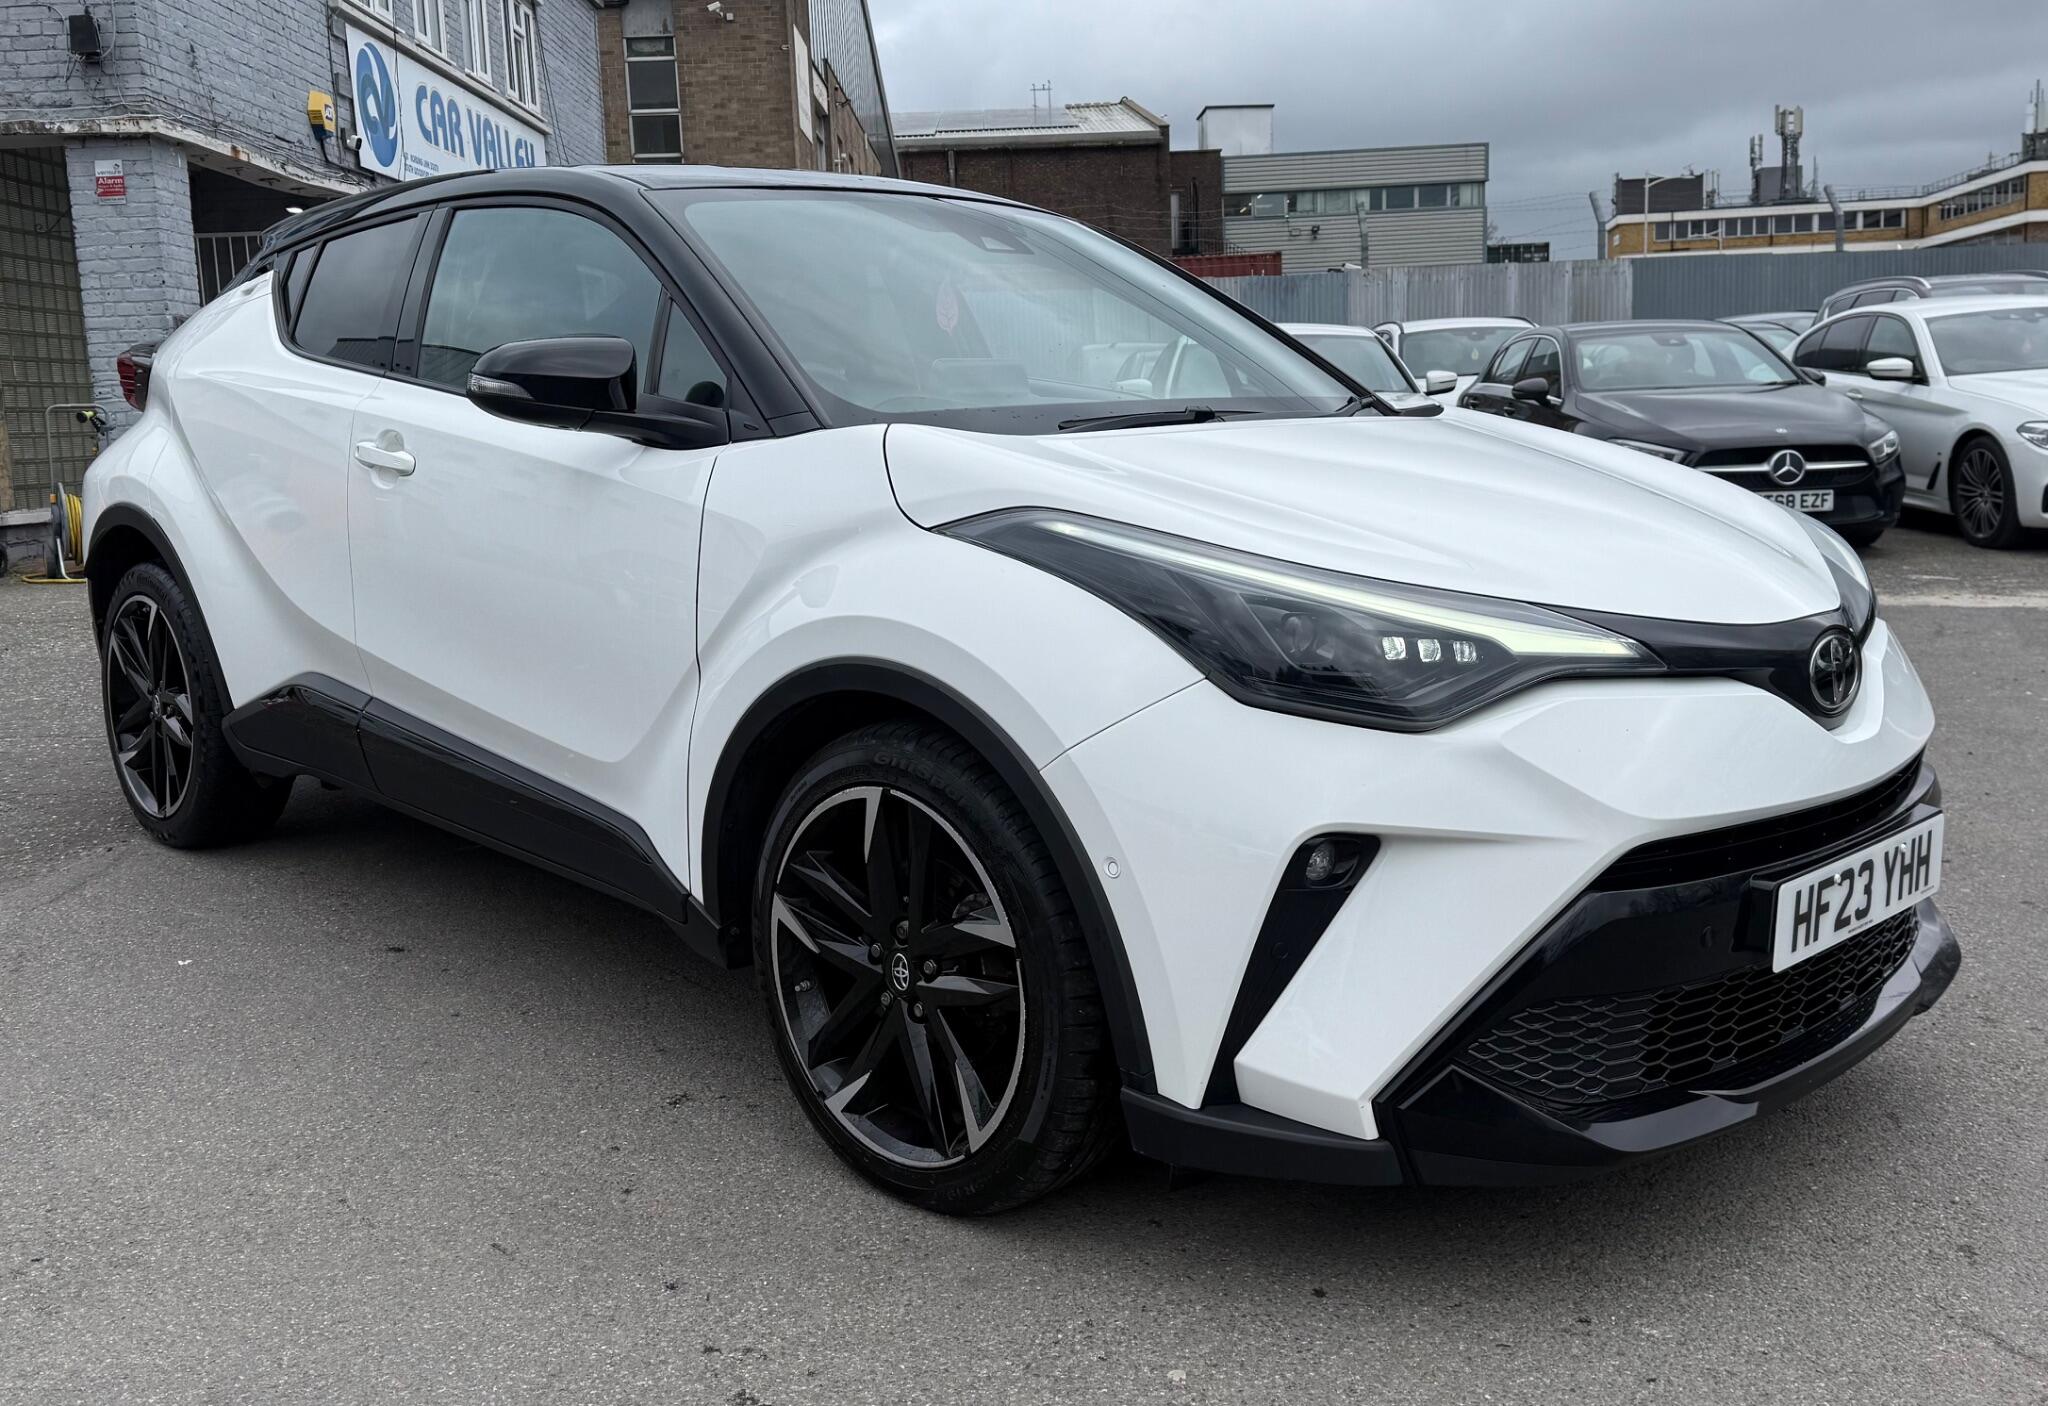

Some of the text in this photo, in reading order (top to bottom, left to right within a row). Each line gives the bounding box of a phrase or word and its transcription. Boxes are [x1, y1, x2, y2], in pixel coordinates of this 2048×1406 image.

[415, 84, 465, 158] CAR
[1800, 492, 1831, 508] EZF
[1791, 830, 1933, 953] HF23 YHH
